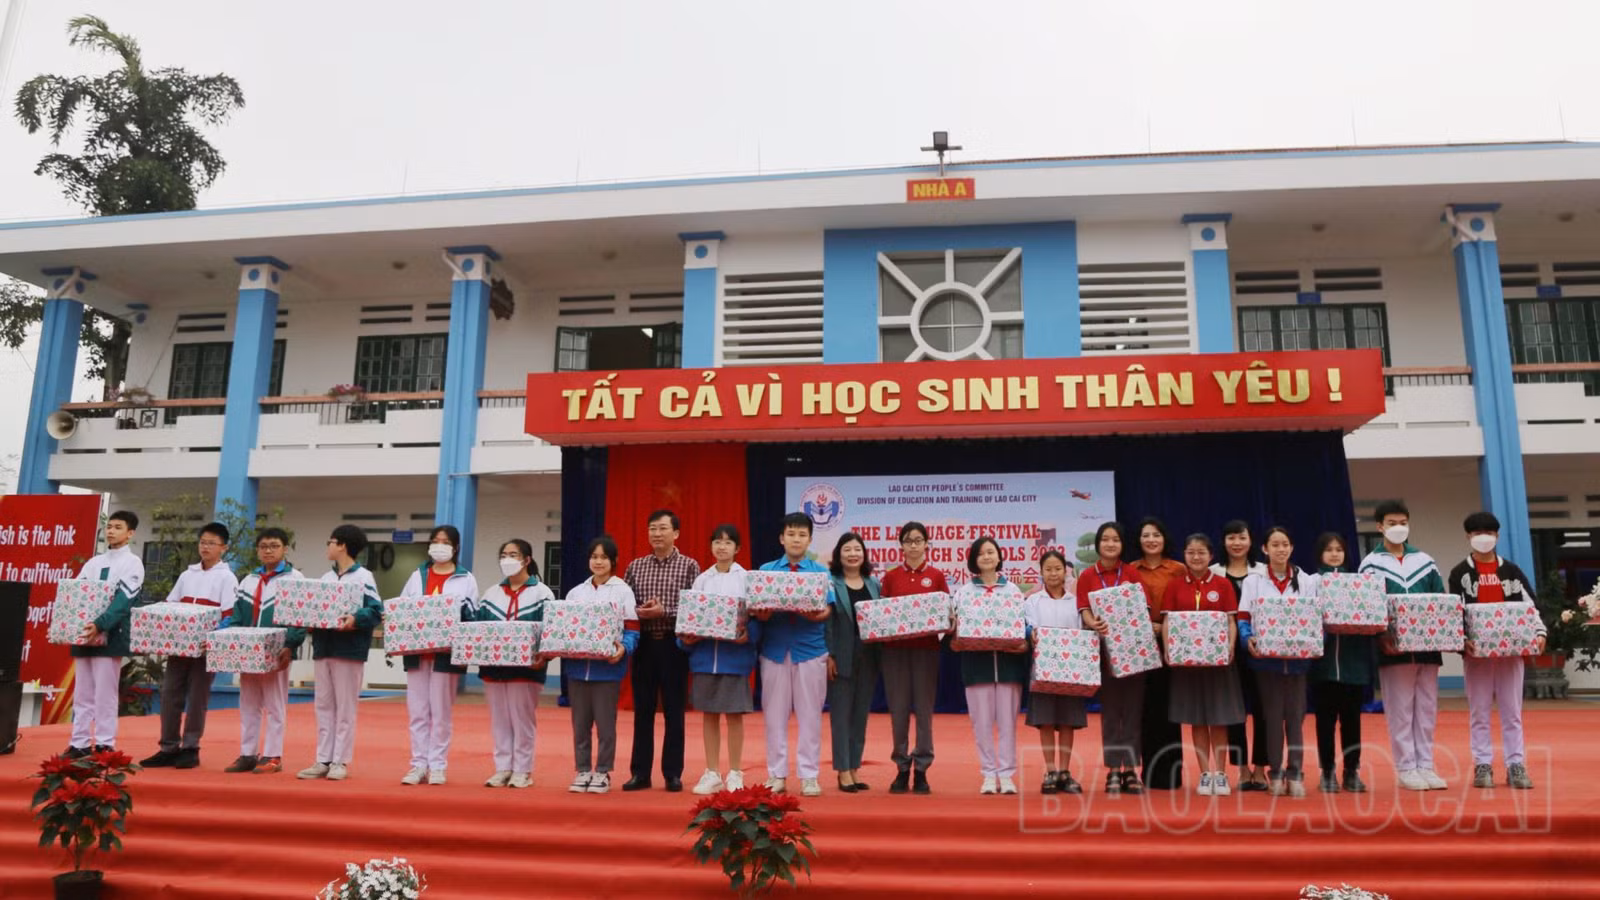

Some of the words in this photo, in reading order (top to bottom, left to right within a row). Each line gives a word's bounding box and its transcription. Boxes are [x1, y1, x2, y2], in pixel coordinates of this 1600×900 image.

[954, 181, 967, 196] A
[562, 372, 643, 421] TẤT
[659, 370, 723, 419] CẢ
[735, 372, 783, 417] VÌ
[802, 379, 901, 424] HỌC
[917, 375, 1040, 413] SINH
[1055, 363, 1194, 409] THÂN
[1212, 360, 1311, 405] YÊU
[1326, 367, 1343, 403] !
[888, 485, 902, 493] LAO
[903, 485, 914, 493] CAI
[916, 484, 931, 492] CITY
[965, 483, 1004, 491] COMMITTEE
[857, 497, 886, 505] DIVISION
[888, 497, 896, 505] OF
[898, 496, 934, 504] EDUCATION
[936, 496, 950, 504] AND
[951, 495, 983, 503] TRAINING
[985, 495, 993, 503] OF
[995, 495, 1008, 503] LAO
[18, 524, 29, 545] is
[32, 524, 51, 546] the
[53, 524, 76, 545] link
[885, 525, 965, 541] LAUAGE
[969, 524, 1041, 539] FESTIVAL
[6, 562, 18, 582] to
[21, 562, 73, 585] cultivate
